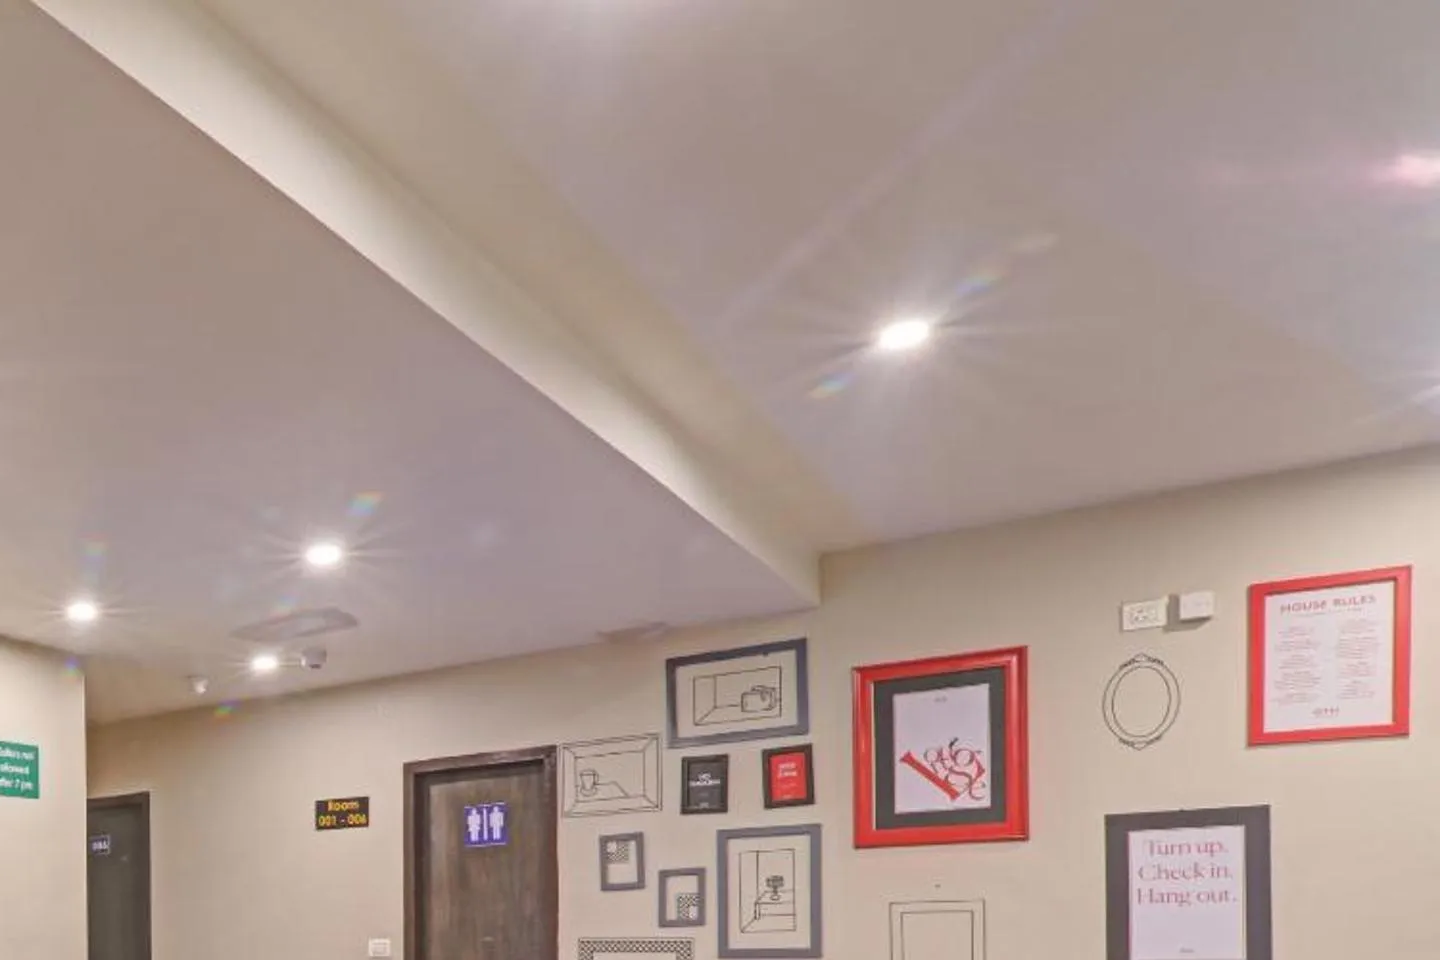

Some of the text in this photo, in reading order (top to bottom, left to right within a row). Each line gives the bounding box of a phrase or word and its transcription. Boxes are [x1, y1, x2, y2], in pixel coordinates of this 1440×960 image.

[1279, 600, 1327, 615] HOUSE
[1333, 595, 1377, 607] RULES
[0, 762, 30, 774] allowed
[327, 800, 359, 811] Room
[318, 814, 336, 826] 001
[1145, 838, 1229, 858] Turn up.
[1137, 861, 1206, 881] Check
[1136, 887, 1238, 907] Hang out.
